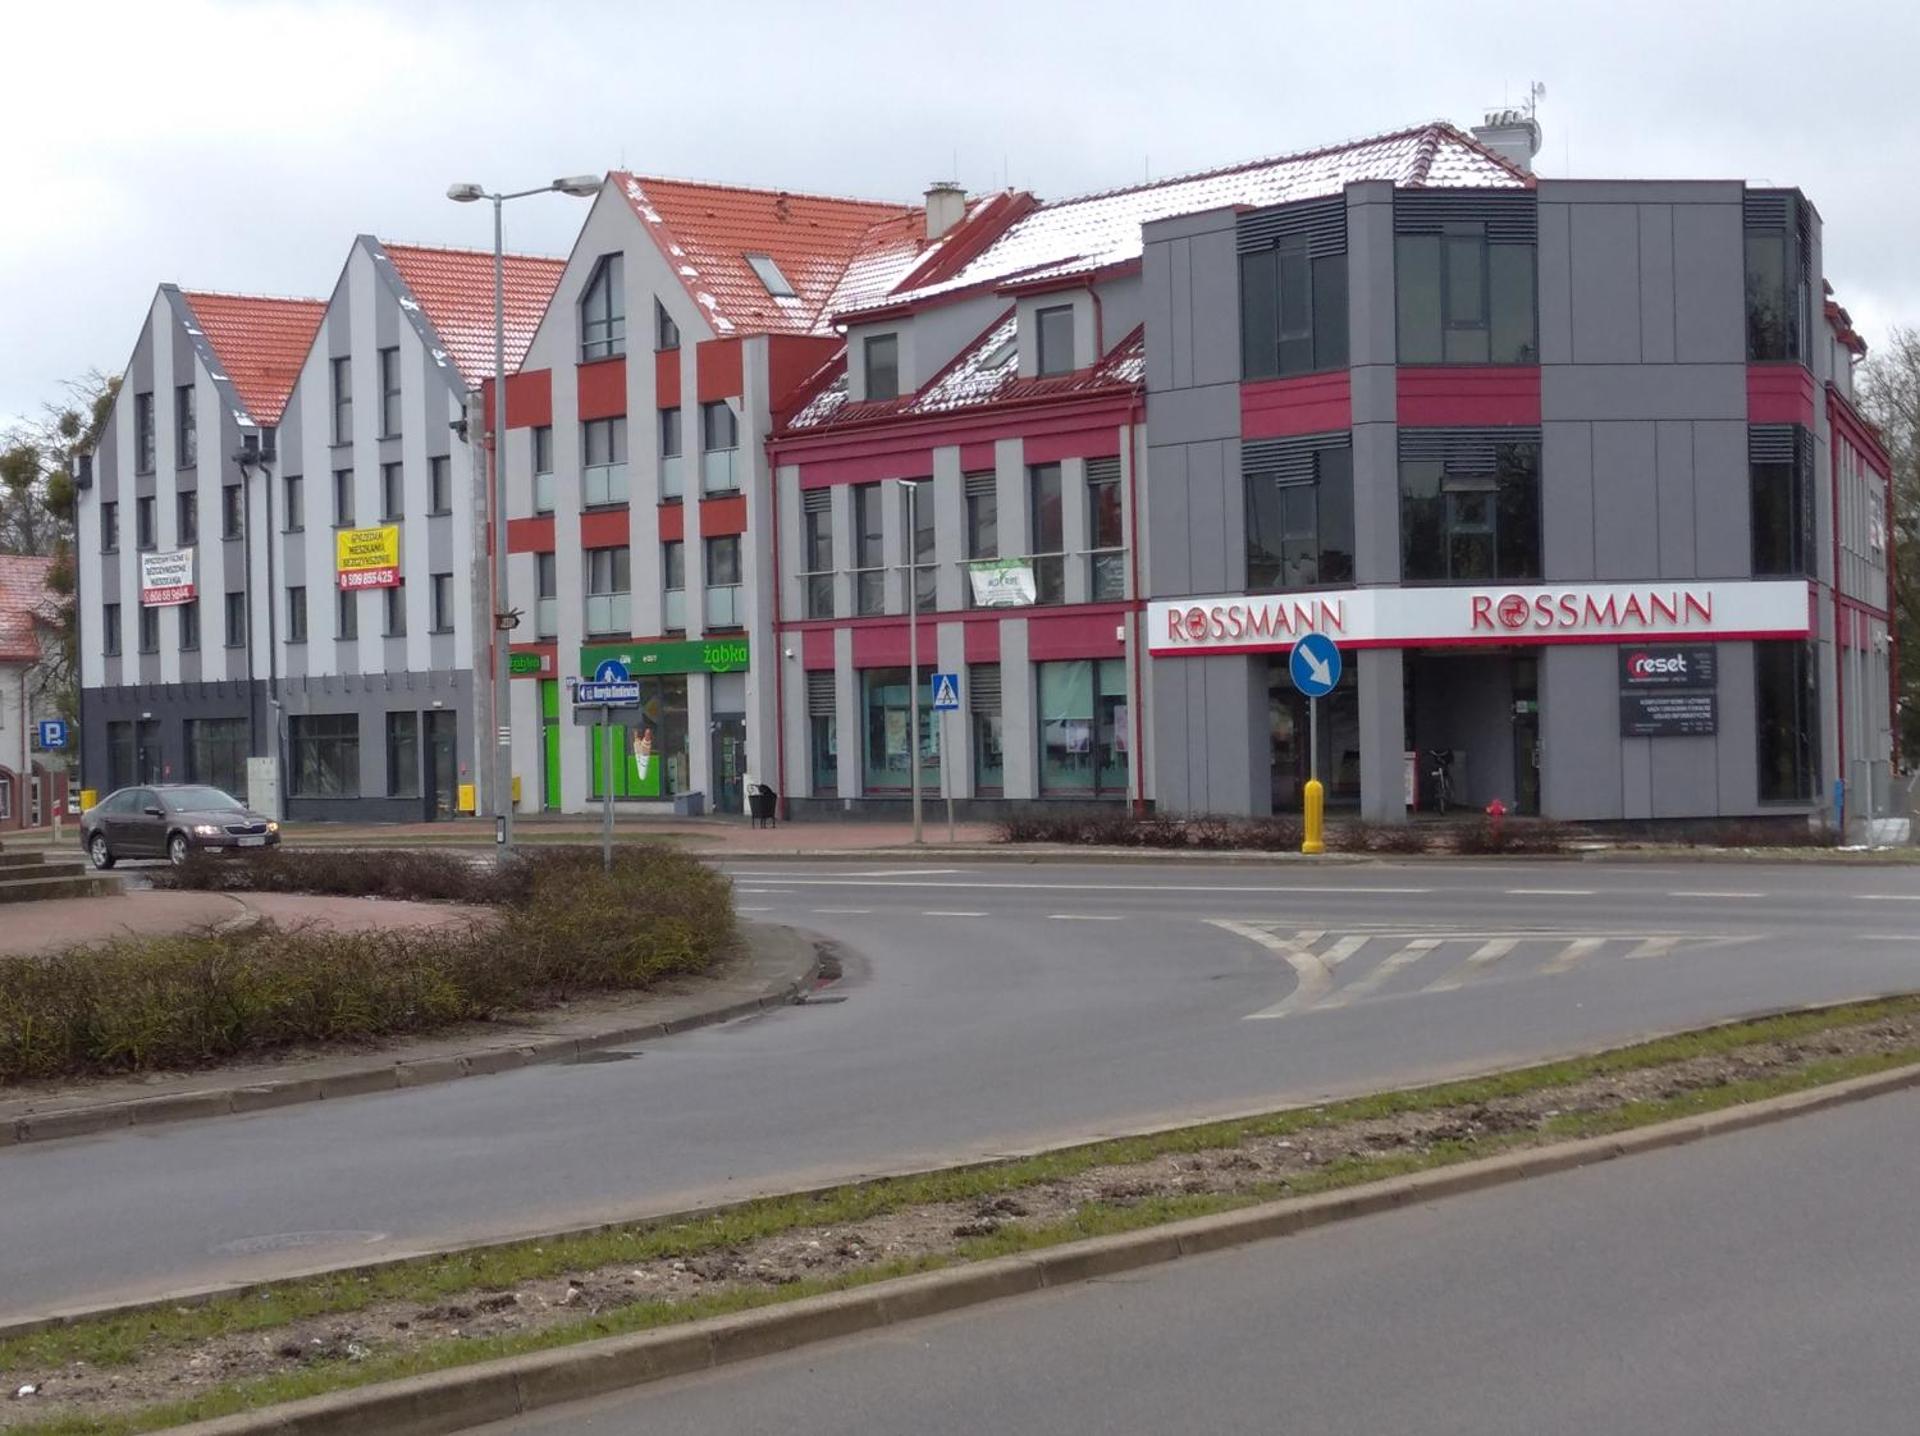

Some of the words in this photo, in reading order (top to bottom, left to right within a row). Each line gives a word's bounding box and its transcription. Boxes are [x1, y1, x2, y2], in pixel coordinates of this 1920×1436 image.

[1168, 600, 1342, 641] ROSSMANN
[1471, 592, 1712, 630] ROSSMANN
[704, 644, 748, 669] żabka
[1635, 653, 1687, 673] reset
[45, 723, 60, 744] P
